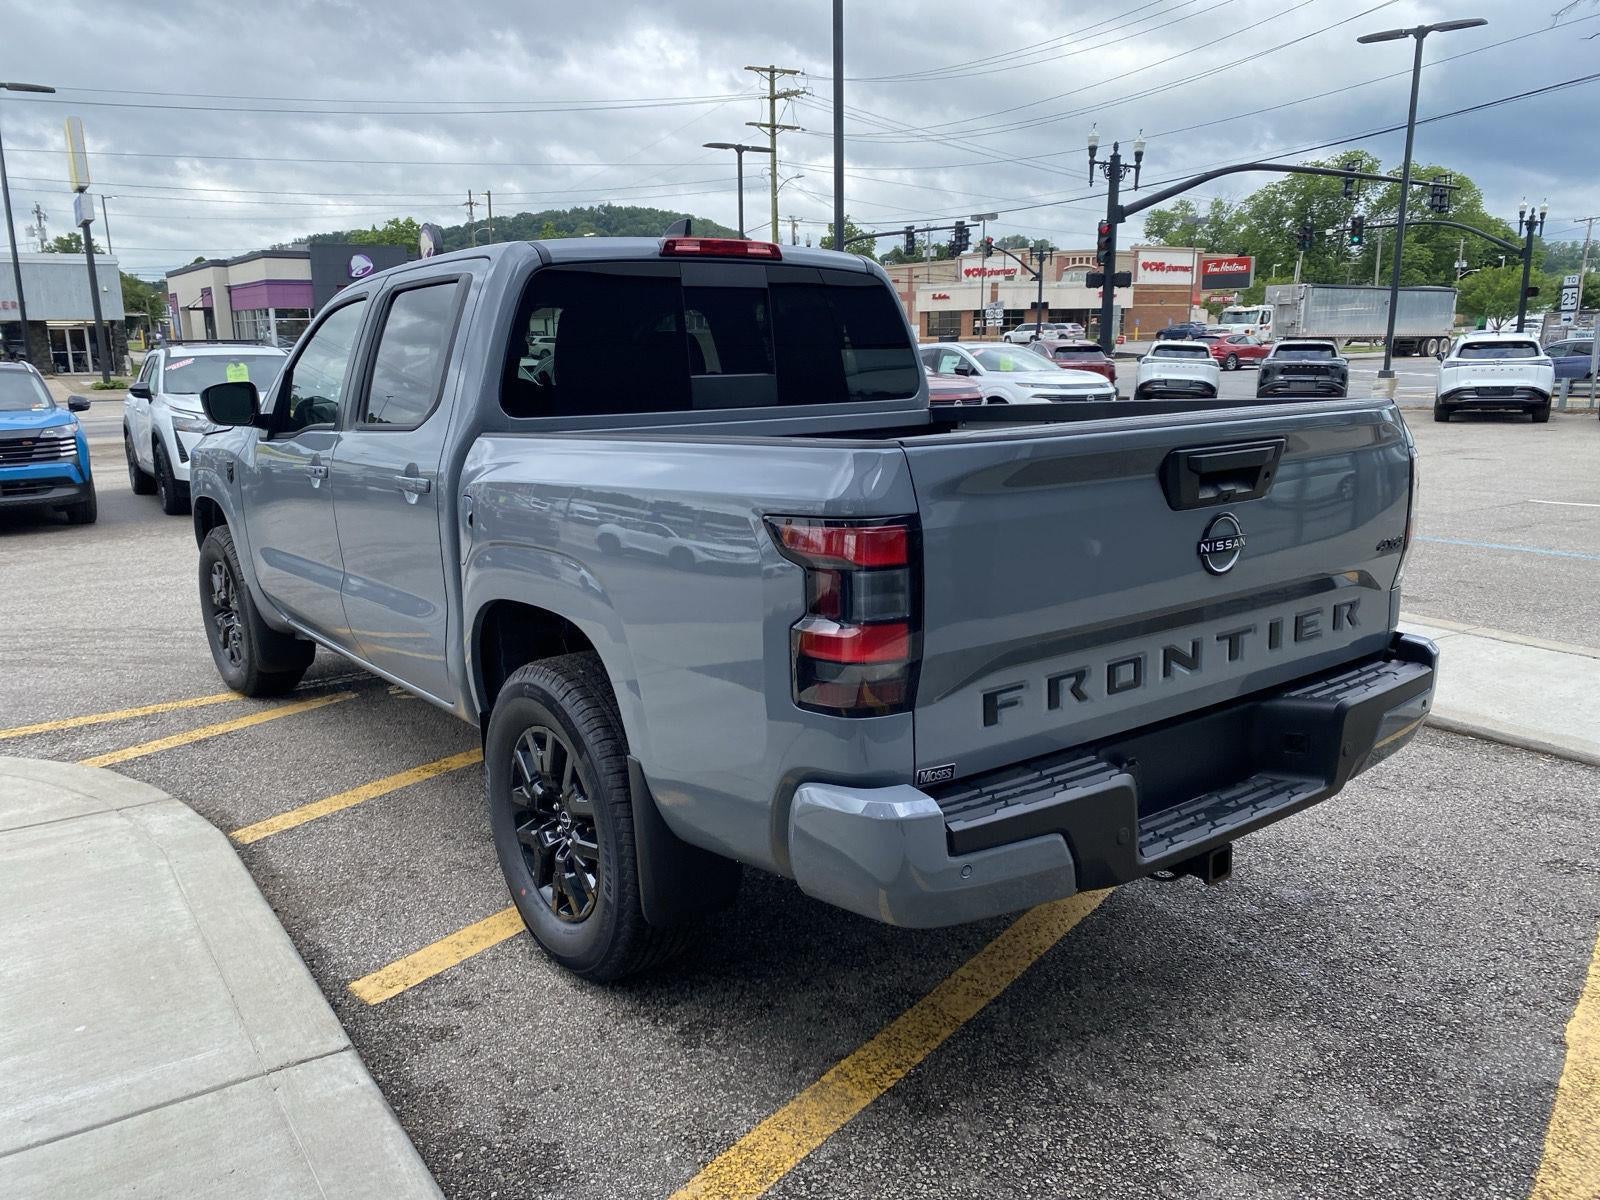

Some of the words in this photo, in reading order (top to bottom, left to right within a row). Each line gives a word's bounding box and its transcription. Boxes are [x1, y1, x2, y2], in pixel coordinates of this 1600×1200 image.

[971, 267, 987, 277] CVS
[1150, 261, 1166, 271] CVS
[1166, 263, 1192, 274] pharmac
[1207, 262, 1220, 273] Tim
[1220, 261, 1247, 272] Hortons
[0, 301, 17, 310] ER
[1562, 292, 1577, 306] 25
[1200, 537, 1247, 553] NISSAN
[981, 598, 1363, 728] FRONTIER
